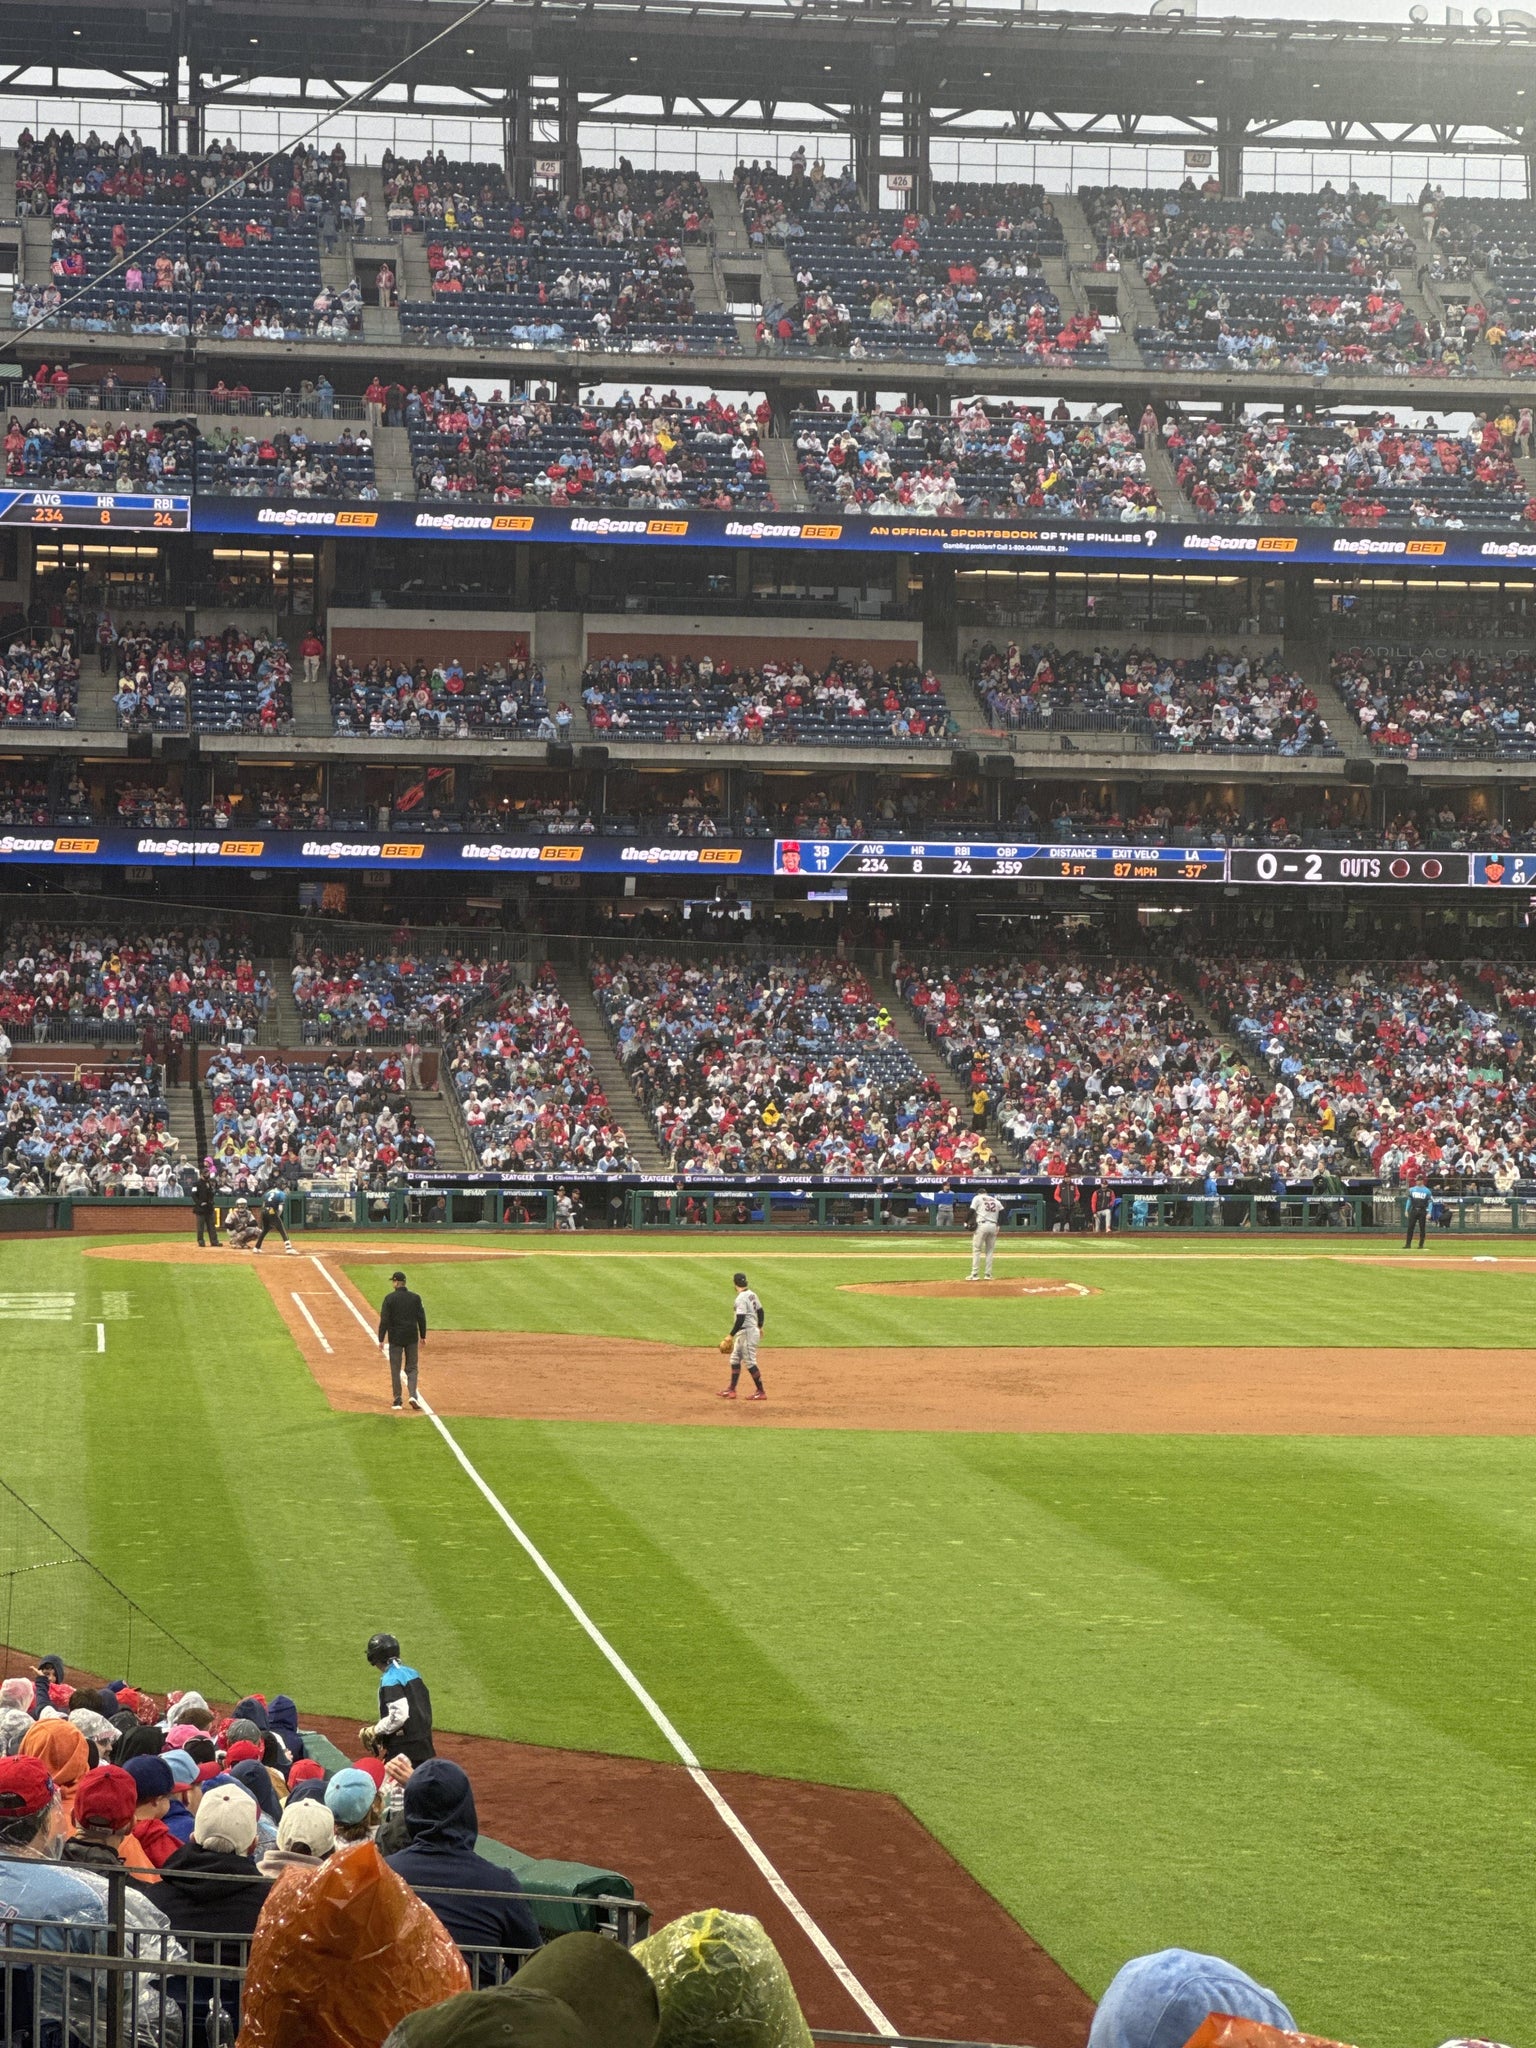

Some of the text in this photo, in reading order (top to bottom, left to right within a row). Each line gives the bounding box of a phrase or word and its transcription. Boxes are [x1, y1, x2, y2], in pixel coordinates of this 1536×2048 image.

[540, 162, 556, 172] 425
[893, 176, 908, 186] 426
[33, 494, 173, 510] AVG HR RBI
[31, 508, 173, 526] .234 8 24
[258, 509, 374, 525] theScore BET
[416, 514, 530, 530] theScore BET
[571, 518, 684, 534] theScore BET
[725, 522, 839, 538] theScore BET
[870, 527, 1142, 543] AN OFFICIAL SPORTSBOOK OF THE PHILLIES
[942, 543, 970, 551] Gambling
[1184, 535, 1293, 551] theScore BET
[1333, 538, 1442, 554] theScore BET
[1349, 646, 1530, 660] CADILLAC HAL OF
[57, 840, 93, 852] BET
[223, 843, 258, 855] BET
[302, 842, 418, 858] theScore BET
[814, 846, 830, 858] 3B
[862, 845, 1018, 857] AVG HR RBI OBP
[462, 845, 578, 861] theScore BET
[621, 848, 738, 863] theScore BET
[1050, 848, 1200, 861] DISTANCE EXIT VELO LA
[816, 860, 827, 871] 11
[858, 858, 1022, 874] .234 8 24 .359
[1061, 862, 1070, 875] 3
[1074, 866, 1086, 876] FT
[1114, 863, 1132, 877] 87
[1134, 867, 1158, 877] MPH
[1340, 858, 1381, 878] OUTS
[1514, 858, 1524, 870] P
[132, 868, 147, 879] 127
[370, 871, 385, 883] 128
[1512, 872, 1526, 884] 61
[640, 1175, 674, 1183] SEATGEEK
[778, 1176, 812, 1184] SEATGEEK
[268, 1193, 275, 1202] 2
[984, 1202, 997, 1213] 32
